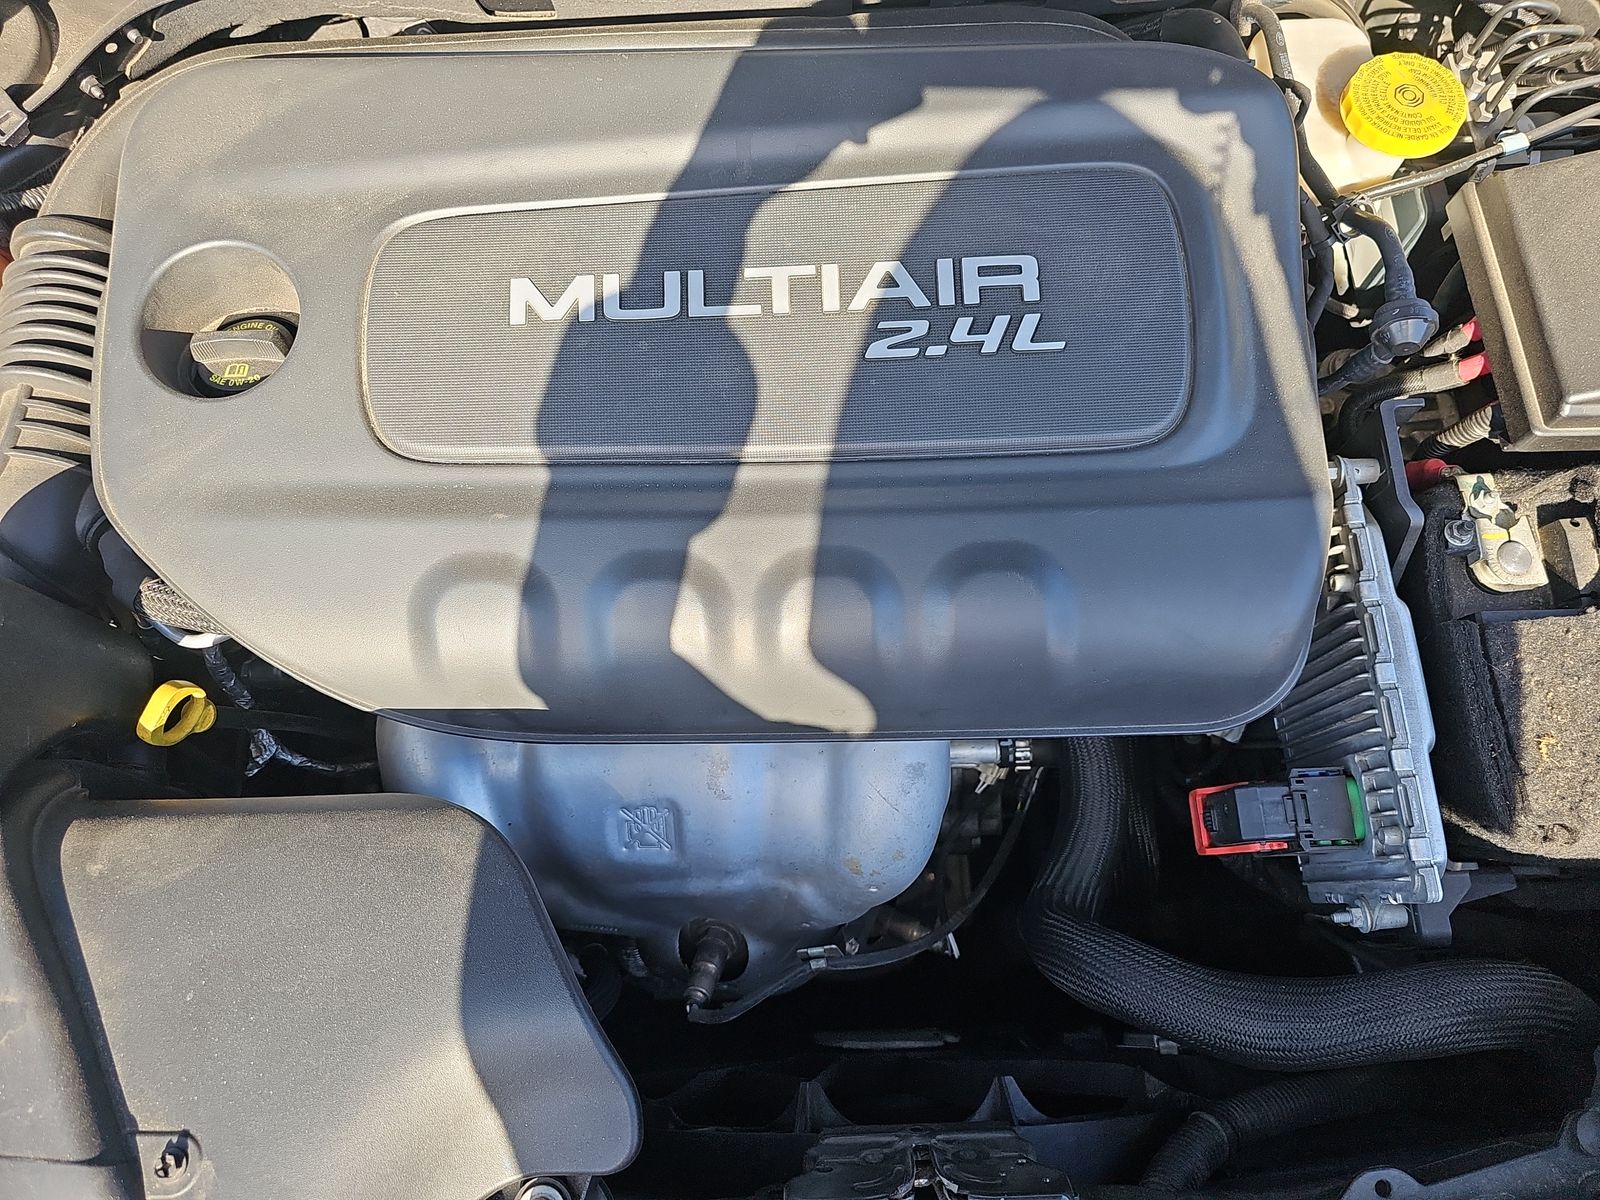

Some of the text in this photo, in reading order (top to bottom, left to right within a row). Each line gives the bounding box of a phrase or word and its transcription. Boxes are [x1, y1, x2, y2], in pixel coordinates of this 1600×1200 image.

[1384, 102, 1422, 119] CONTENANT
[1371, 122, 1403, 139] NETTOYER
[508, 253, 1042, 326] MULTIAIR
[863, 313, 1068, 360] 2.4L
[209, 374, 262, 386] SAE 0W-20
